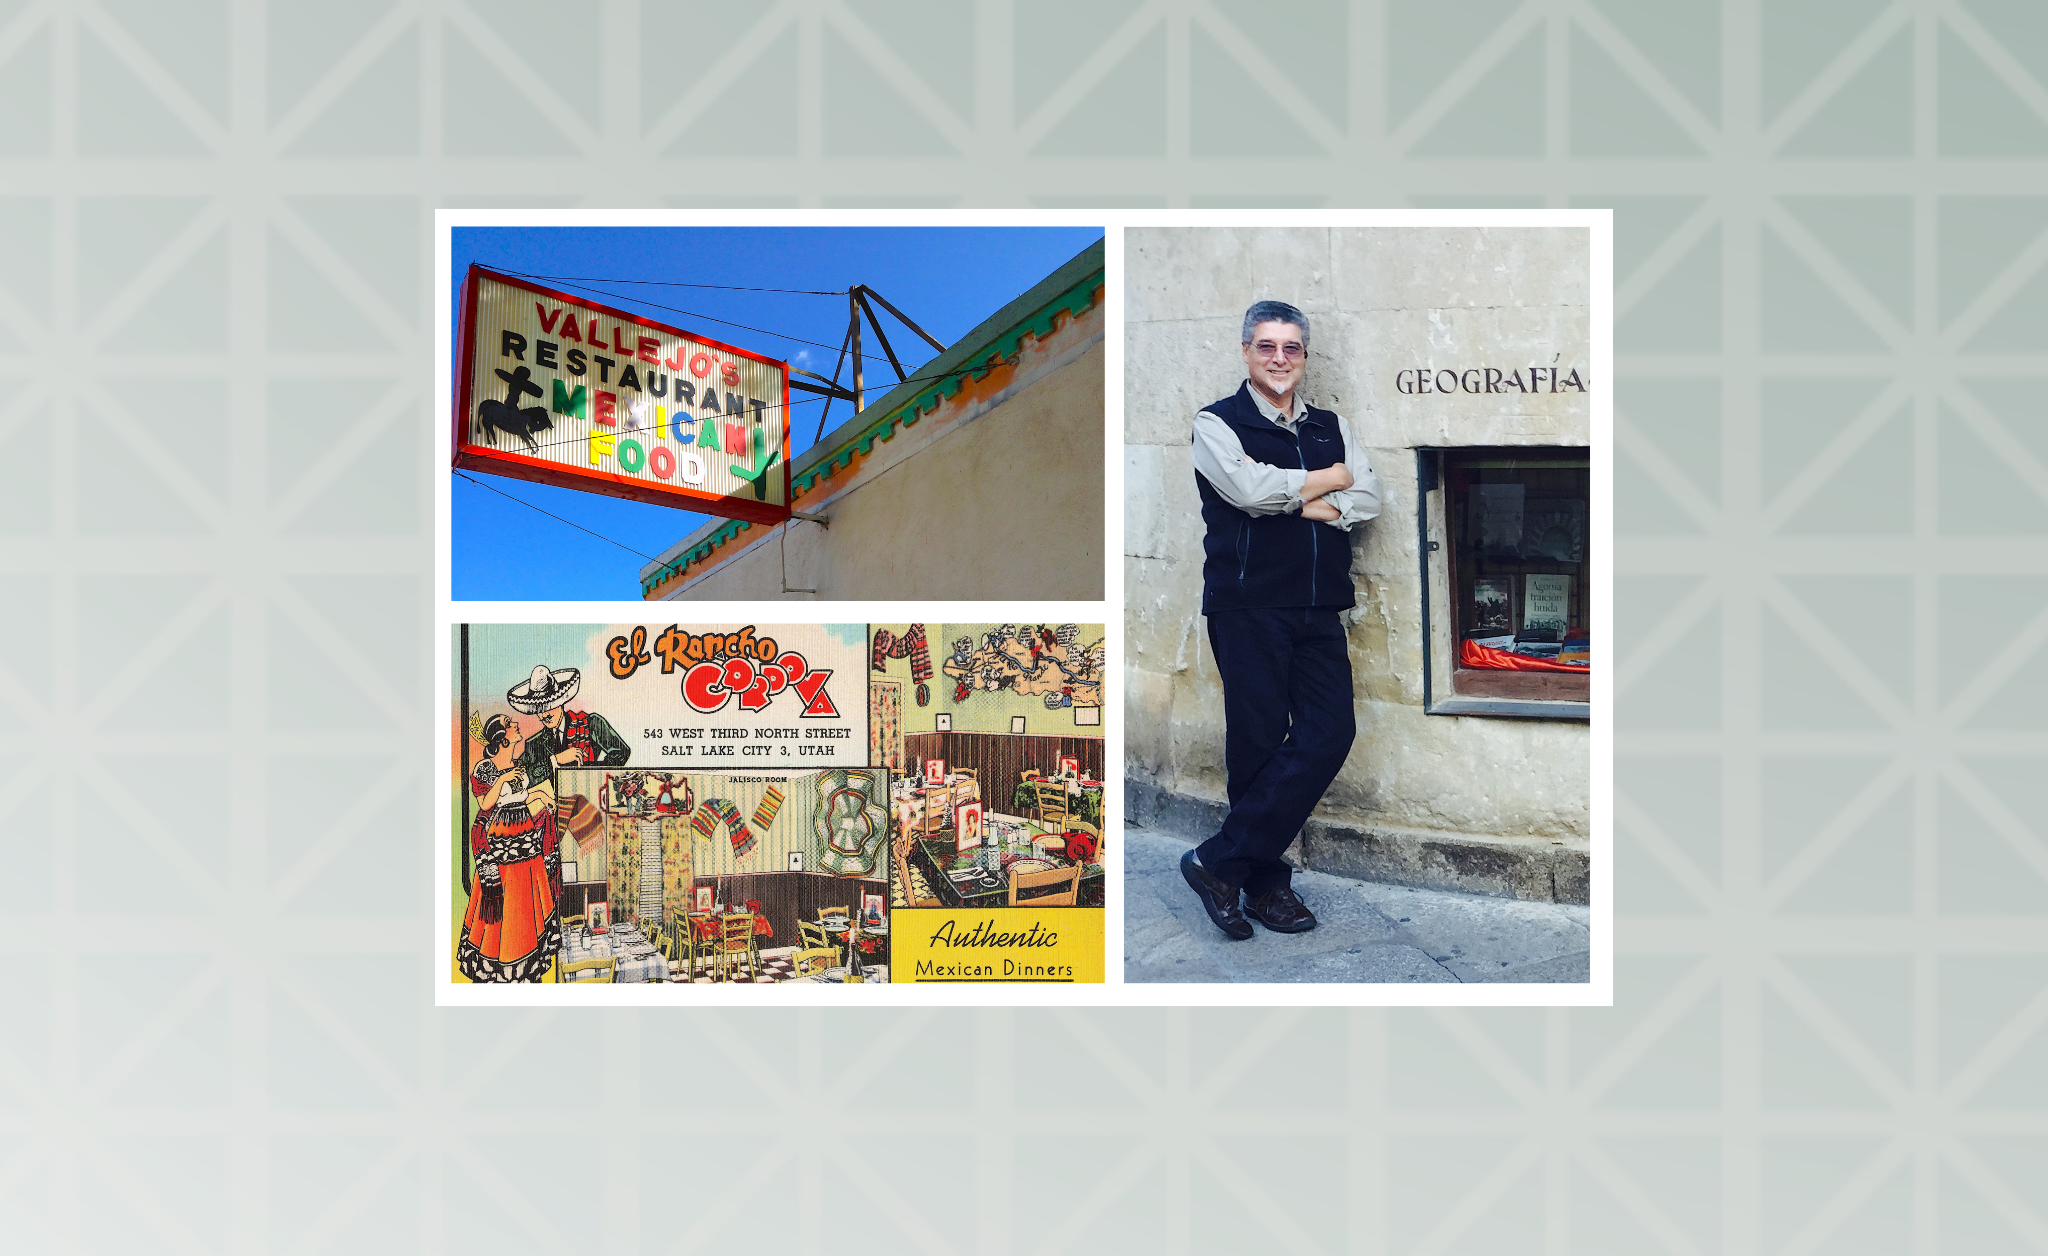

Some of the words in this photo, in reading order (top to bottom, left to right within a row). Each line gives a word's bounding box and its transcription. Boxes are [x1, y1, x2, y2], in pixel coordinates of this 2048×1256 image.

[536, 302, 740, 387] VALLEJO'S
[502, 329, 767, 423] RESTAURANT
[552, 378, 746, 457] MEXICAN
[590, 429, 705, 485] FOOD
[606, 625, 651, 680] El
[654, 623, 779, 675] Rancho
[681, 651, 841, 718] CORDOVA
[643, 728, 663, 739] 543
[669, 728, 704, 739] WEST
[710, 728, 749, 739] THIRD
[754, 728, 800, 739] NORTH
[805, 728, 851, 739] STREET
[661, 745, 694, 756] SALT
[701, 745, 735, 756] LAKE
[742, 745, 772, 756] CITY
[780, 745, 791, 757] 3,
[799, 745, 835, 756] UTAH
[929, 919, 1059, 948] Authentic
[915, 959, 993, 976] Mexican
[1003, 959, 1073, 976] Dinners
